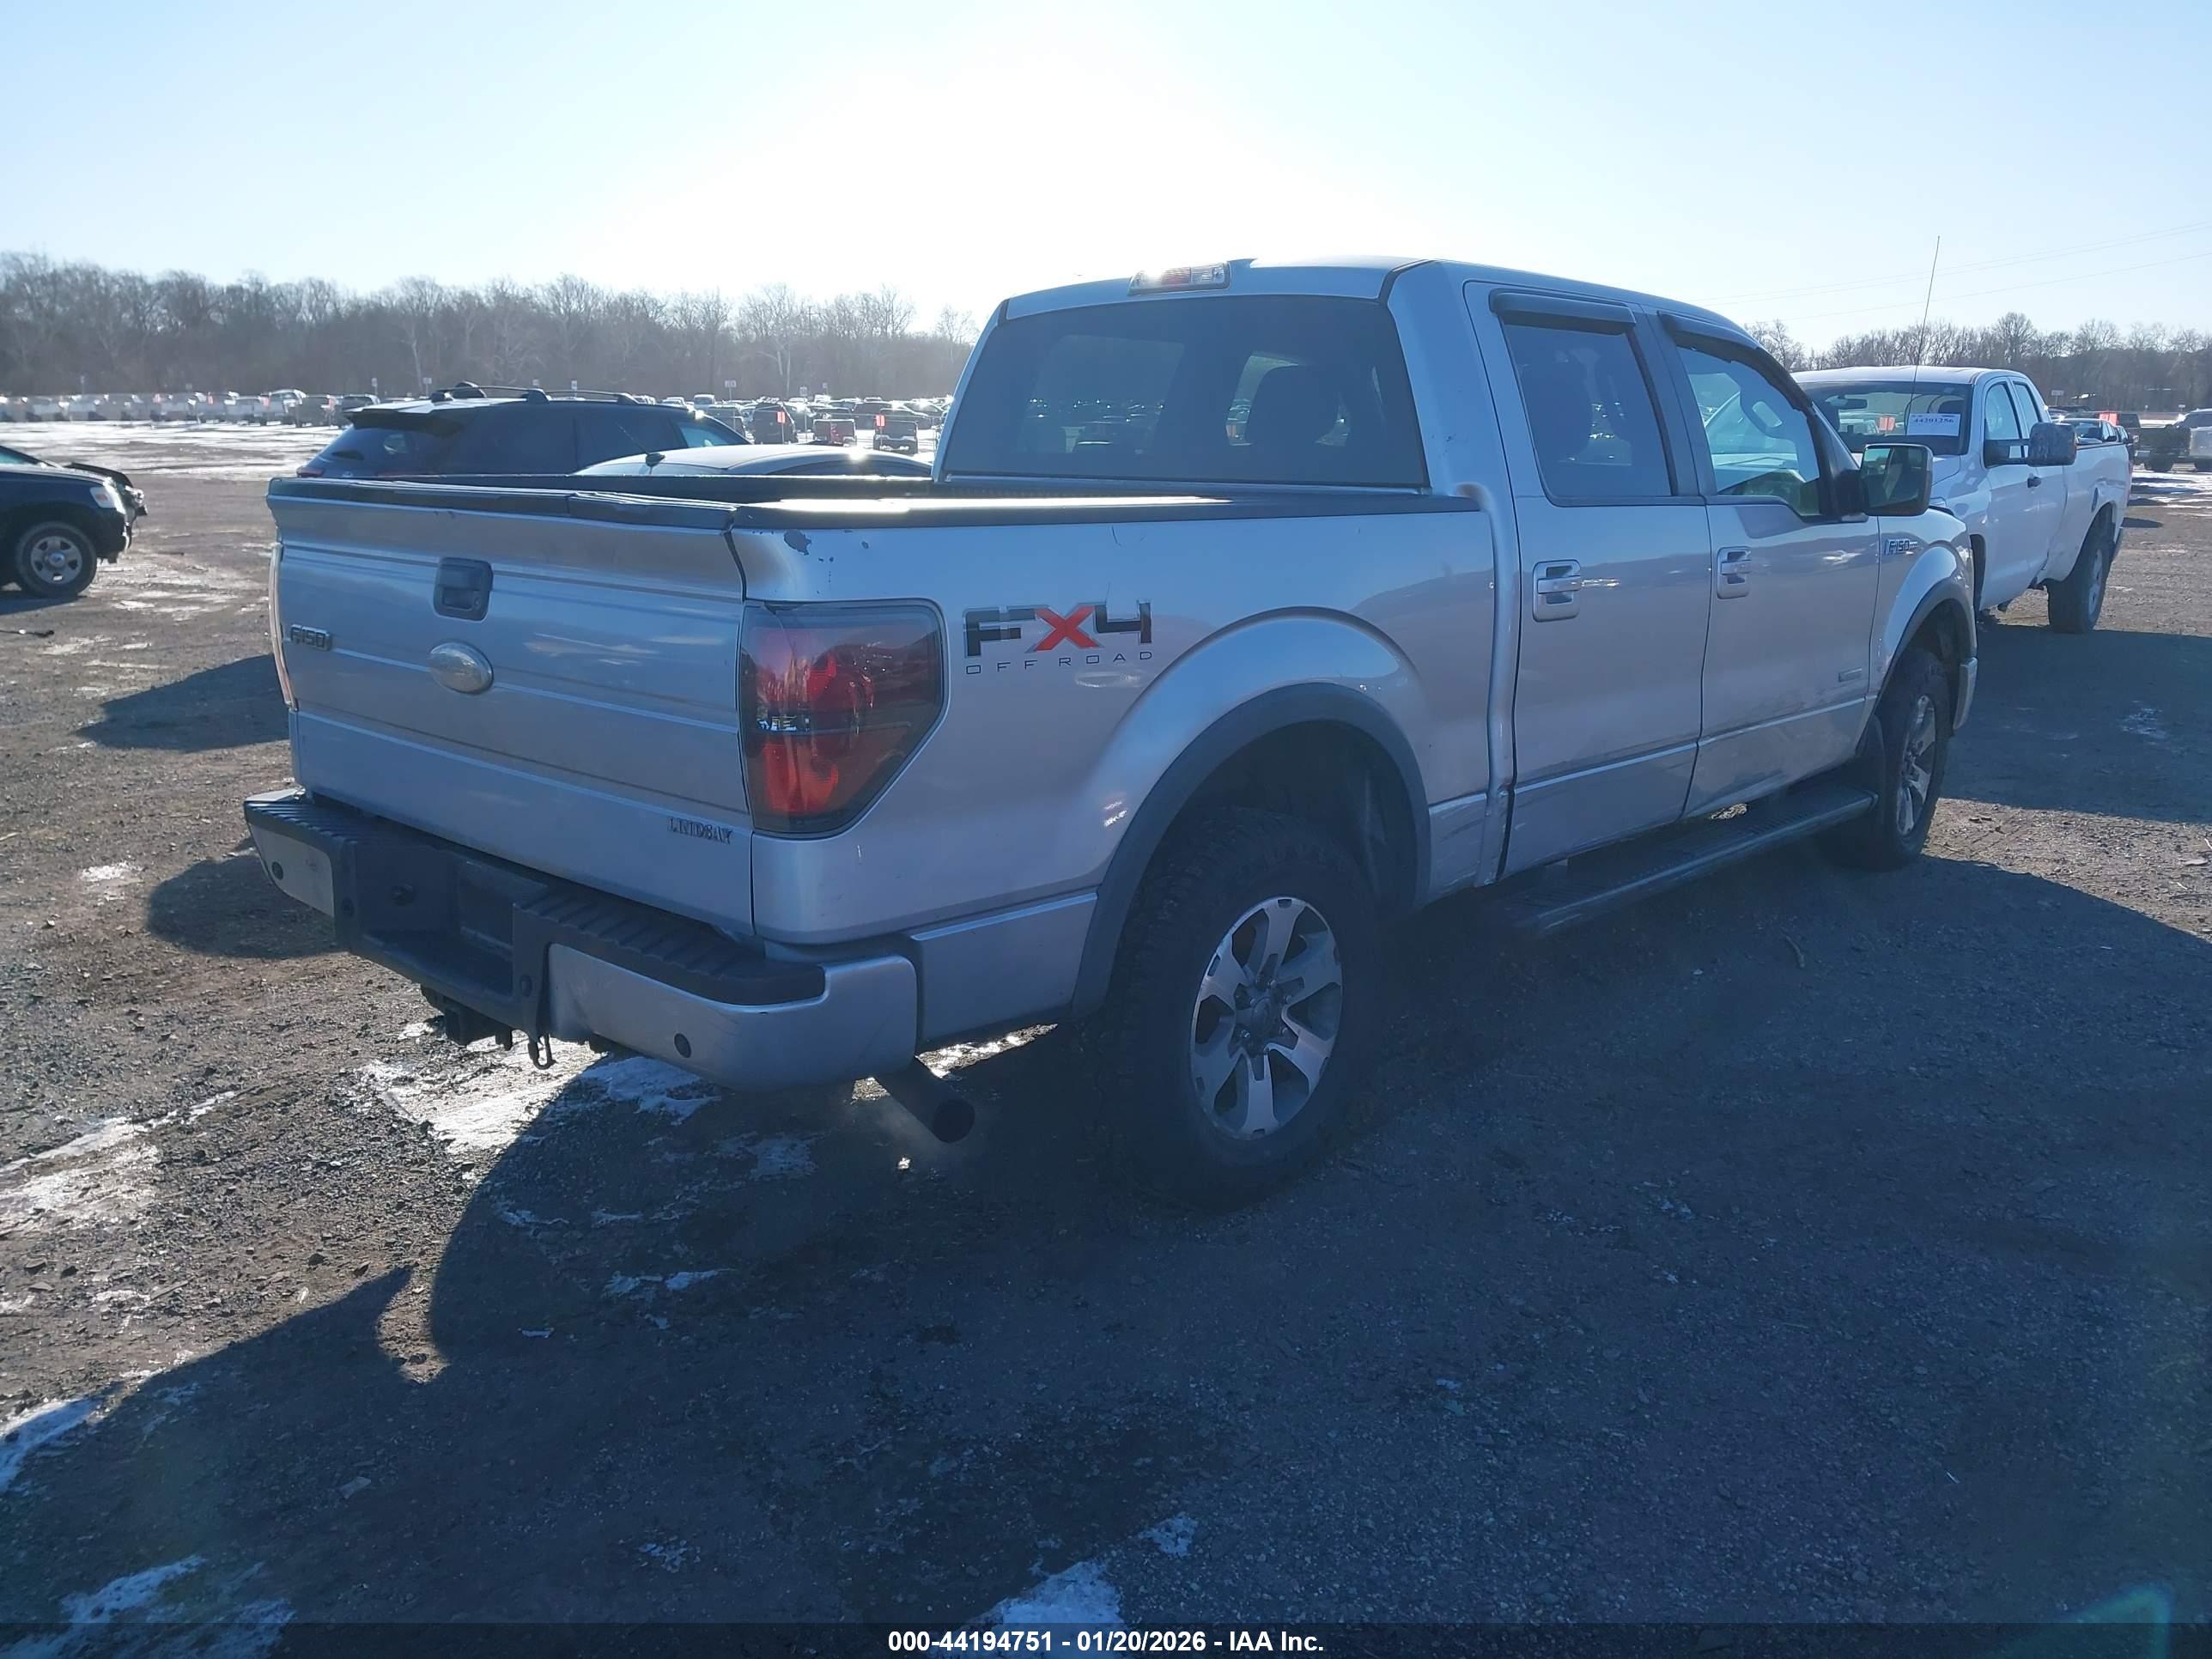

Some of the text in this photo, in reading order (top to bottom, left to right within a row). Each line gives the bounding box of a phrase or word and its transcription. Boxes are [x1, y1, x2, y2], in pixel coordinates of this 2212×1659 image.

[963, 601, 1152, 658] FX4
[965, 650, 1153, 675] OFF ROAD
